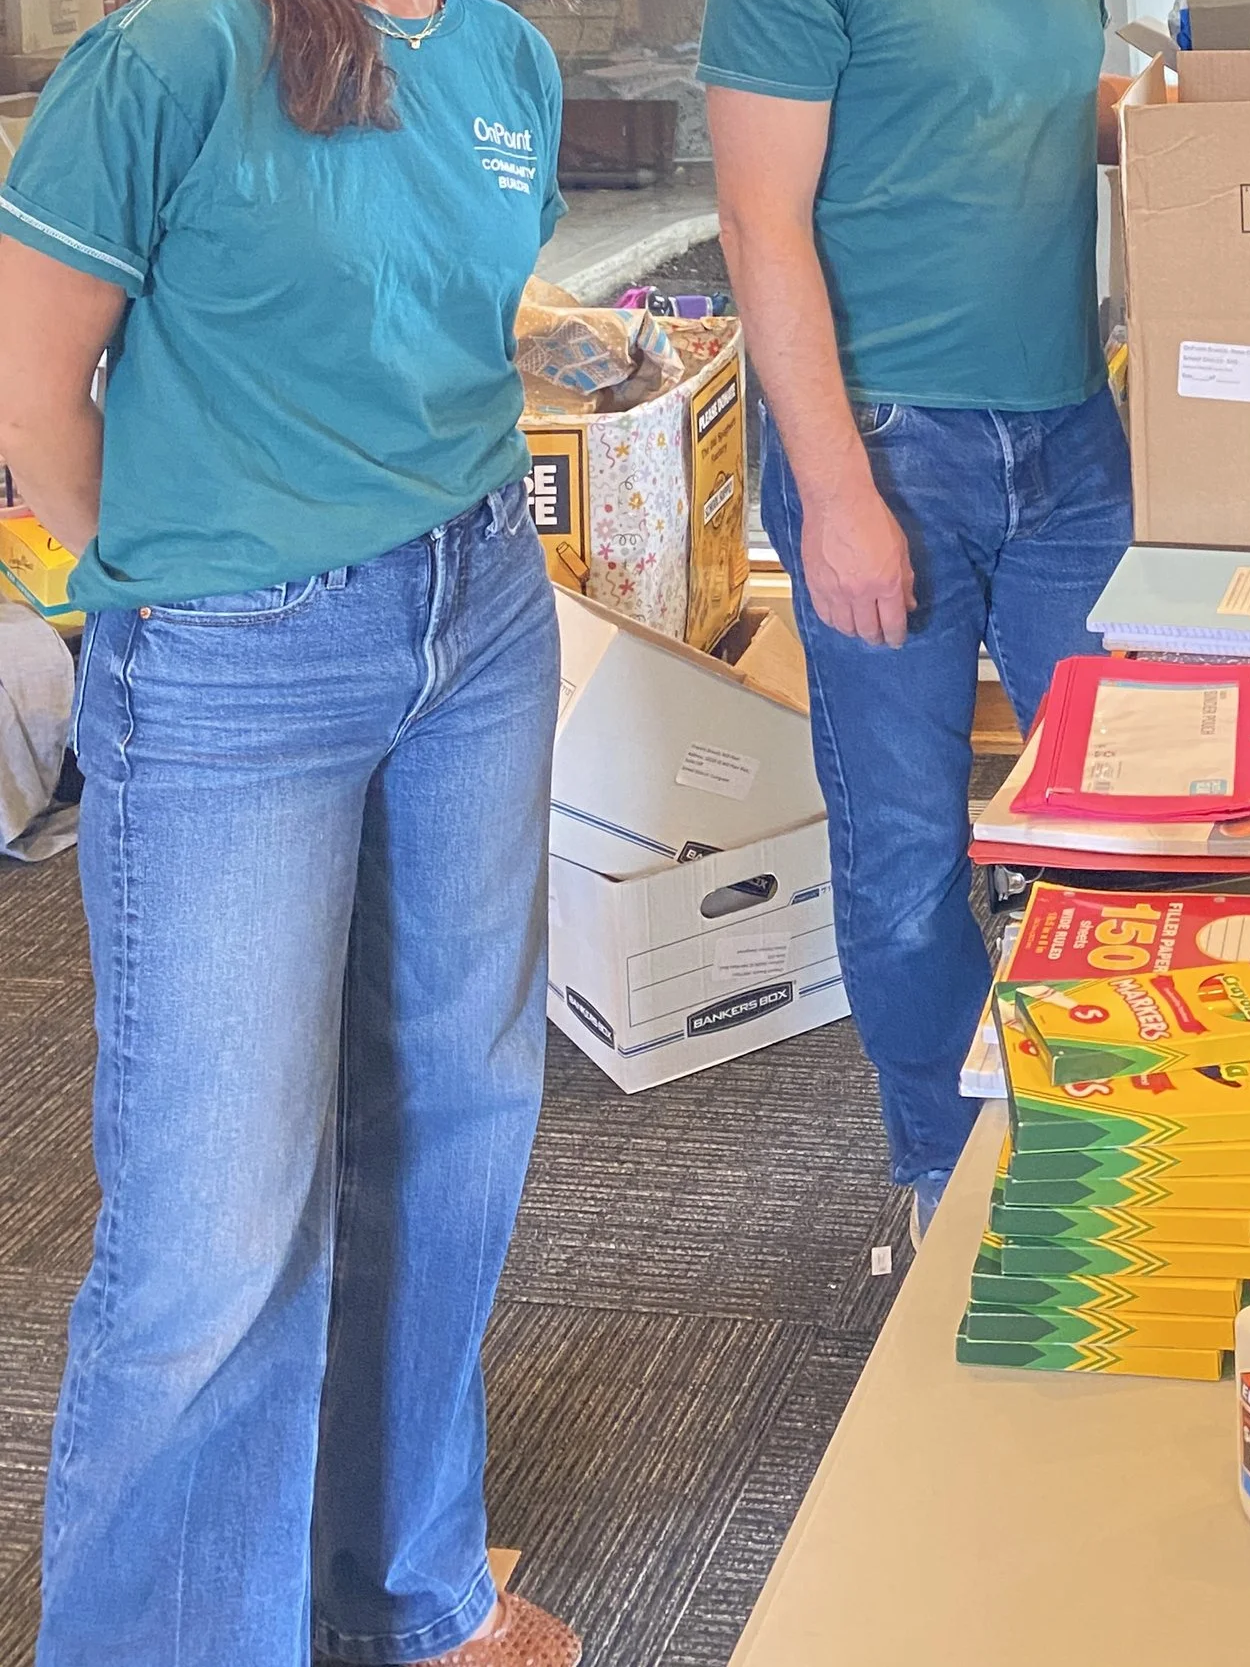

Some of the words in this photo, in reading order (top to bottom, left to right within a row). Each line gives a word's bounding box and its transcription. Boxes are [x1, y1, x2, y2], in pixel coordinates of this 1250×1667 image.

[473, 117, 533, 152] OnPoint
[1058, 908, 1076, 931] WIDE
[1073, 920, 1093, 950] sheets
[1087, 903, 1161, 971] 150
[1160, 902, 1184, 938] FILLER
[1048, 931, 1069, 960] RULED
[1153, 938, 1175, 973] PAPER
[693, 999, 758, 1030] BANKERS
[758, 987, 788, 1007] BOX
[1107, 977, 1172, 1041] MARKERS
